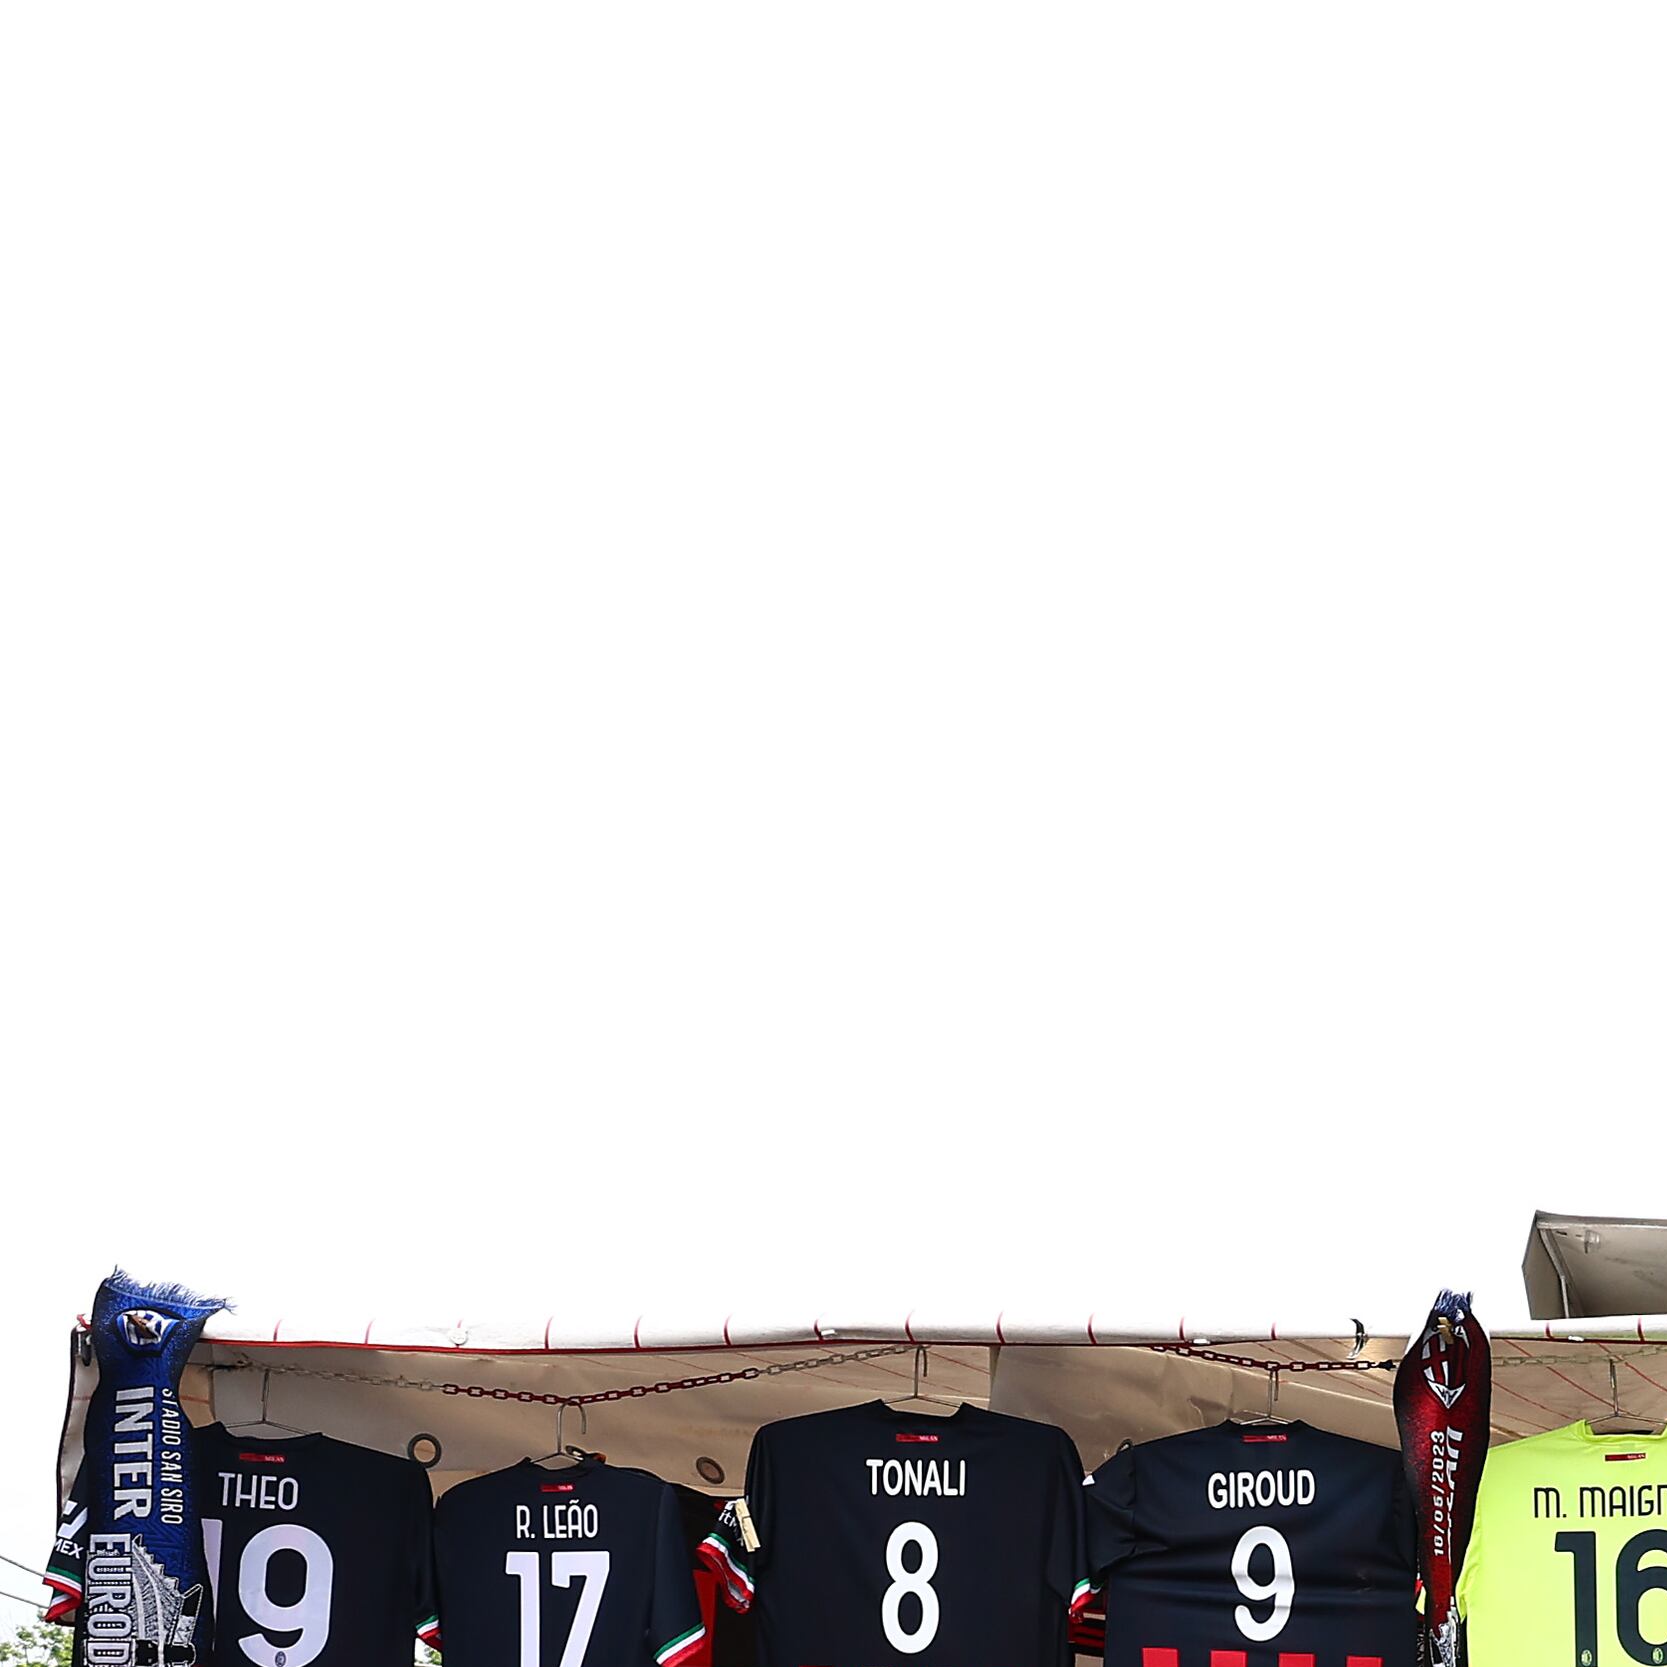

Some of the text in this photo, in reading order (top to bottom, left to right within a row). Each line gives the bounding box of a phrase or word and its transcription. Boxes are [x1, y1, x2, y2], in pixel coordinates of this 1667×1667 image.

[112, 1387, 152, 1521] INTER
[218, 1471, 299, 1511] THEO
[866, 1458, 966, 1497] TONALI
[1208, 1469, 1316, 1509] GIROUD
[517, 1501, 598, 1540] R. LEÃO
[1534, 1485, 1566, 1519] M.
[881, 1521, 940, 1654] 8
[1230, 1525, 1295, 1642] 9
